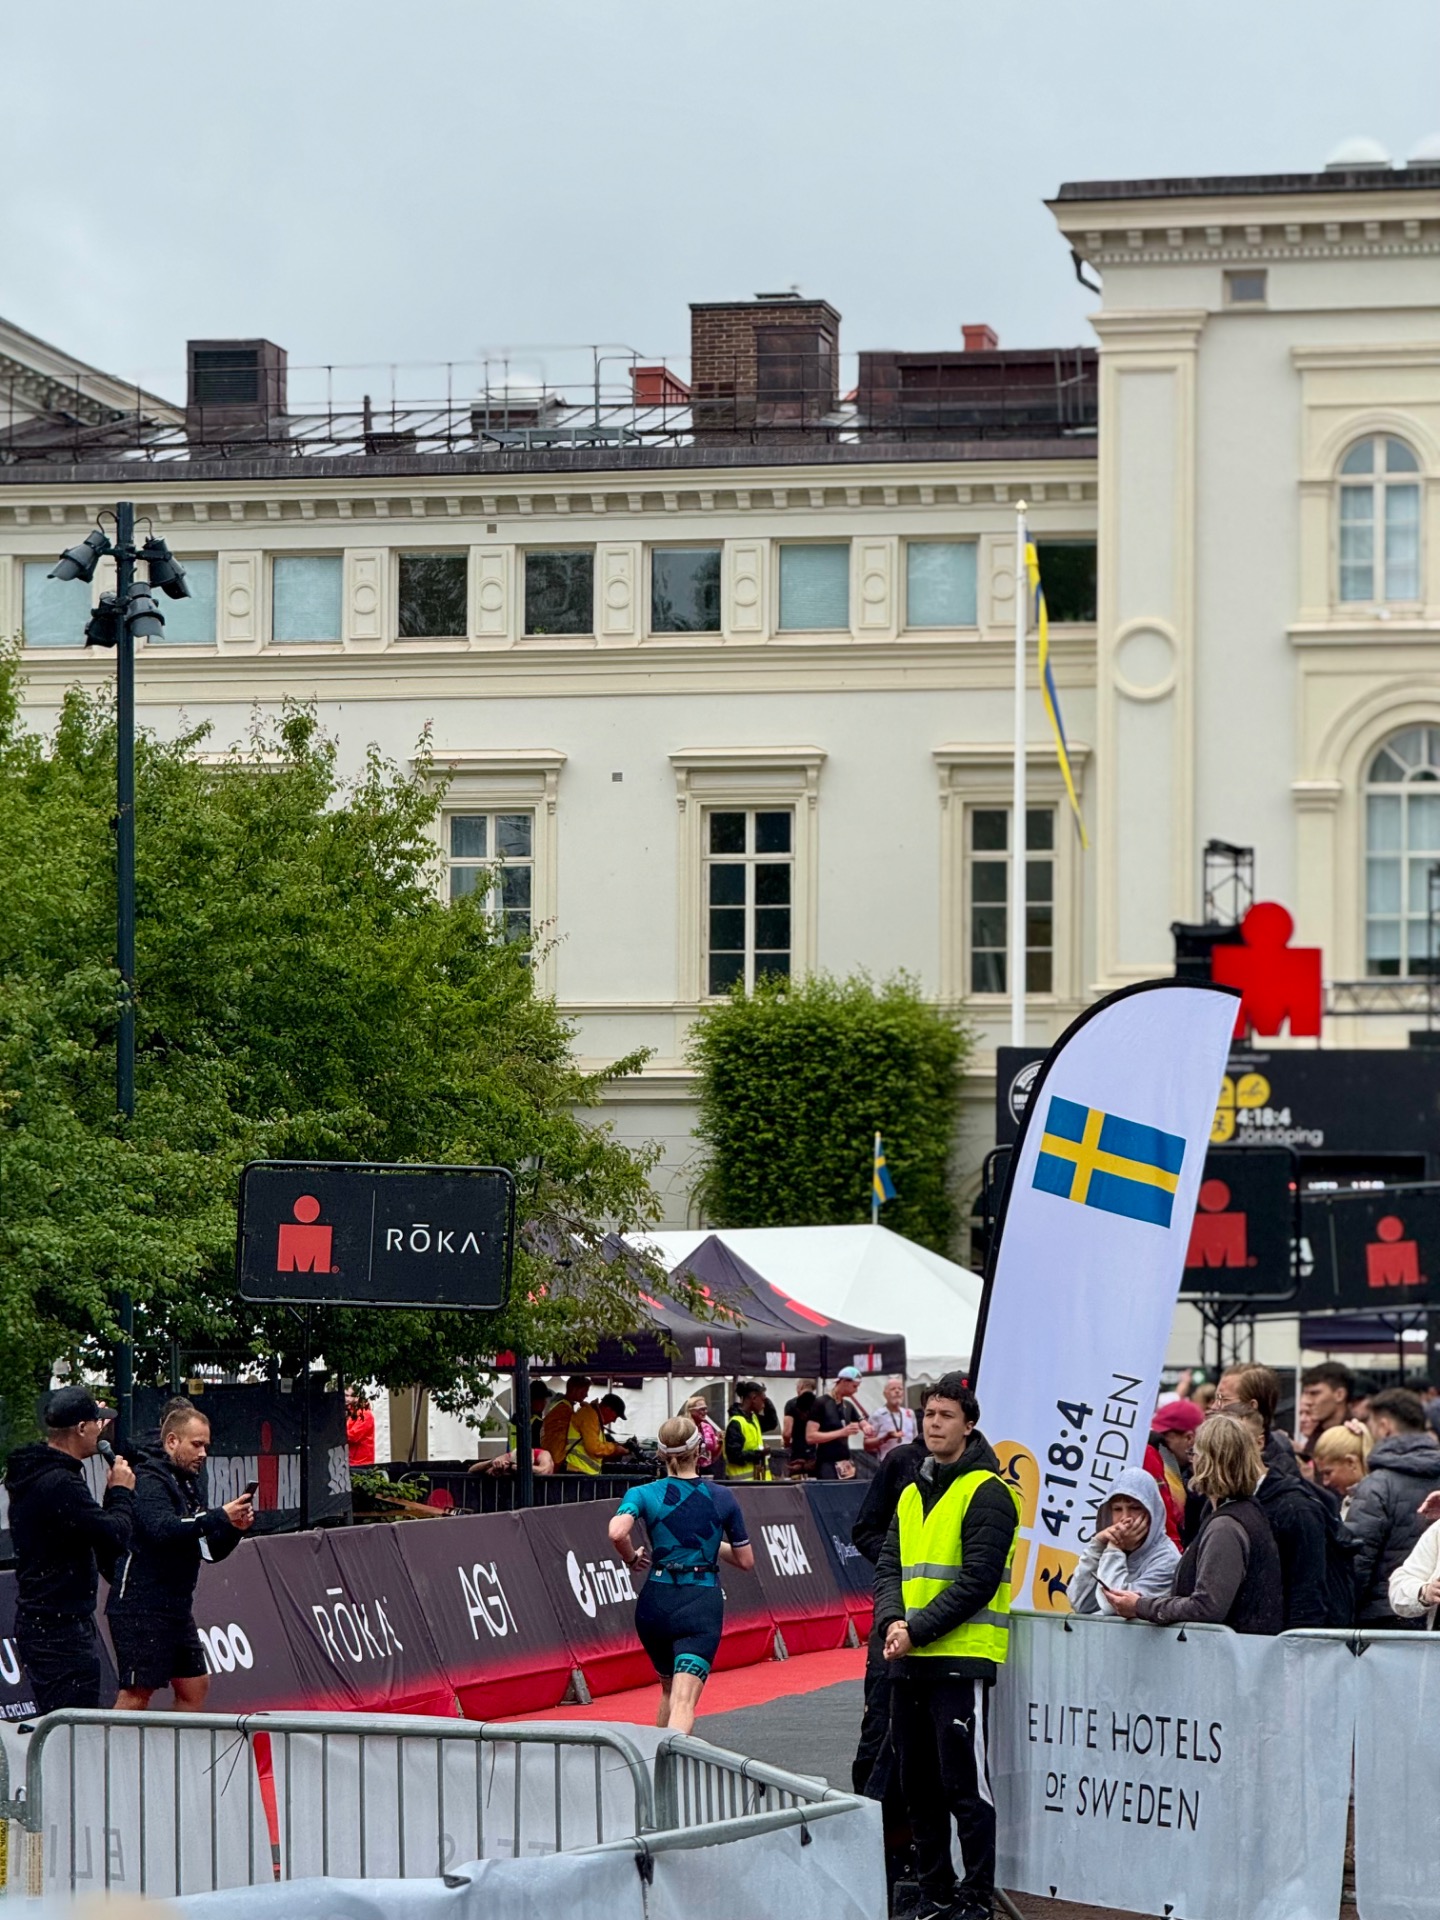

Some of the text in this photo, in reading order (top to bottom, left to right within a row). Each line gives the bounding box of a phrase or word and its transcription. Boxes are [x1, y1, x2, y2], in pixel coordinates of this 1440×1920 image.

[1236, 1107, 1292, 1126] 4:18:4
[1041, 1399, 1094, 1537] 4:18:4
[761, 1523, 813, 1577] HOKA
[5, 1701, 37, 1717] CYCLING
[1028, 1702, 1223, 1764] ELITE HOTELS
[1045, 1771, 1200, 1832] OF SWEDEN
